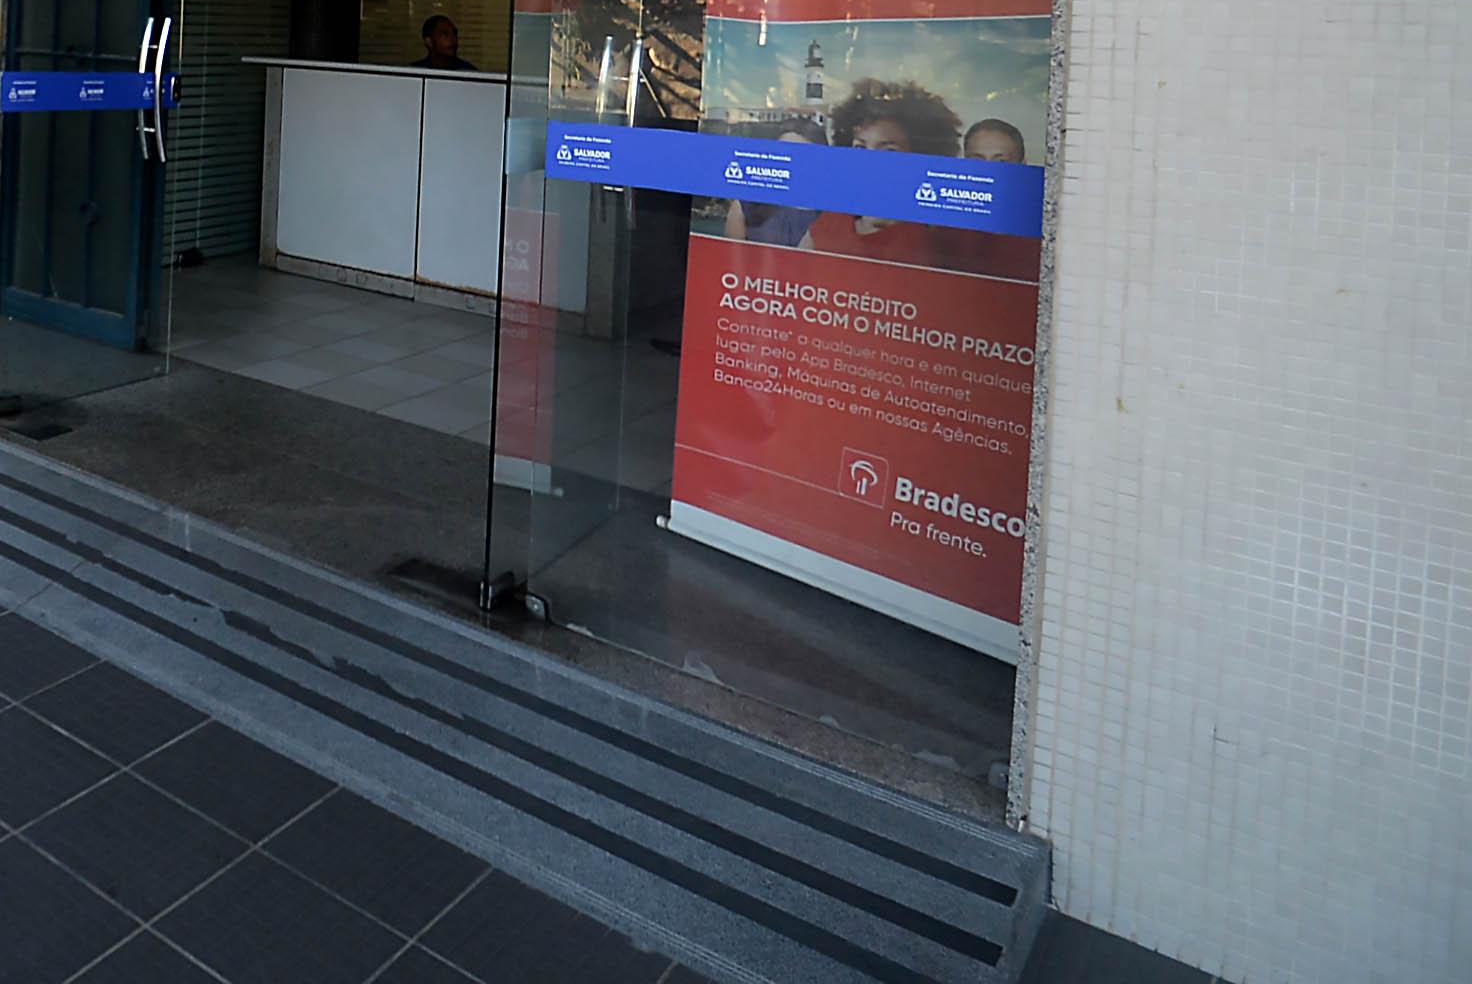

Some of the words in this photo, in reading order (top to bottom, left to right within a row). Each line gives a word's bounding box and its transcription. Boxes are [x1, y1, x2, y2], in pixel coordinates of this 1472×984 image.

[745, 166, 790, 179] SALVADOR
[940, 187, 993, 202] SALVADOR
[721, 273, 739, 290] O
[744, 275, 828, 304] MELHOR
[832, 291, 917, 320] CRÉDITO
[719, 292, 798, 320] AGORA
[802, 306, 850, 329] COM
[853, 316, 870, 333] O
[874, 319, 957, 351] MELHOR
[962, 335, 1034, 366] PRAZO
[716, 334, 756, 353] lugar
[761, 345, 796, 361] pelo
[800, 352, 830, 369] App
[833, 359, 905, 388] Bradesco,
[910, 376, 972, 402] Internet
[812, 338, 876, 359] qualquer
[880, 349, 914, 368] hora
[919, 361, 929, 372] e
[933, 363, 958, 377] em
[961, 368, 1033, 393] qualque
[714, 368, 824, 406] Banco24Horas
[827, 398, 845, 411] ou
[849, 403, 871, 417] em
[876, 409, 928, 432] nossas
[932, 421, 1013, 455] Agências.
[715, 351, 782, 378] Banking,
[787, 366, 857, 395] Máquinas
[860, 386, 880, 400] de
[884, 390, 1030, 439] Autoatendimento,
[890, 511, 920, 536] Pra
[925, 524, 988, 558] frente.
[894, 476, 1026, 537] Bradesco
